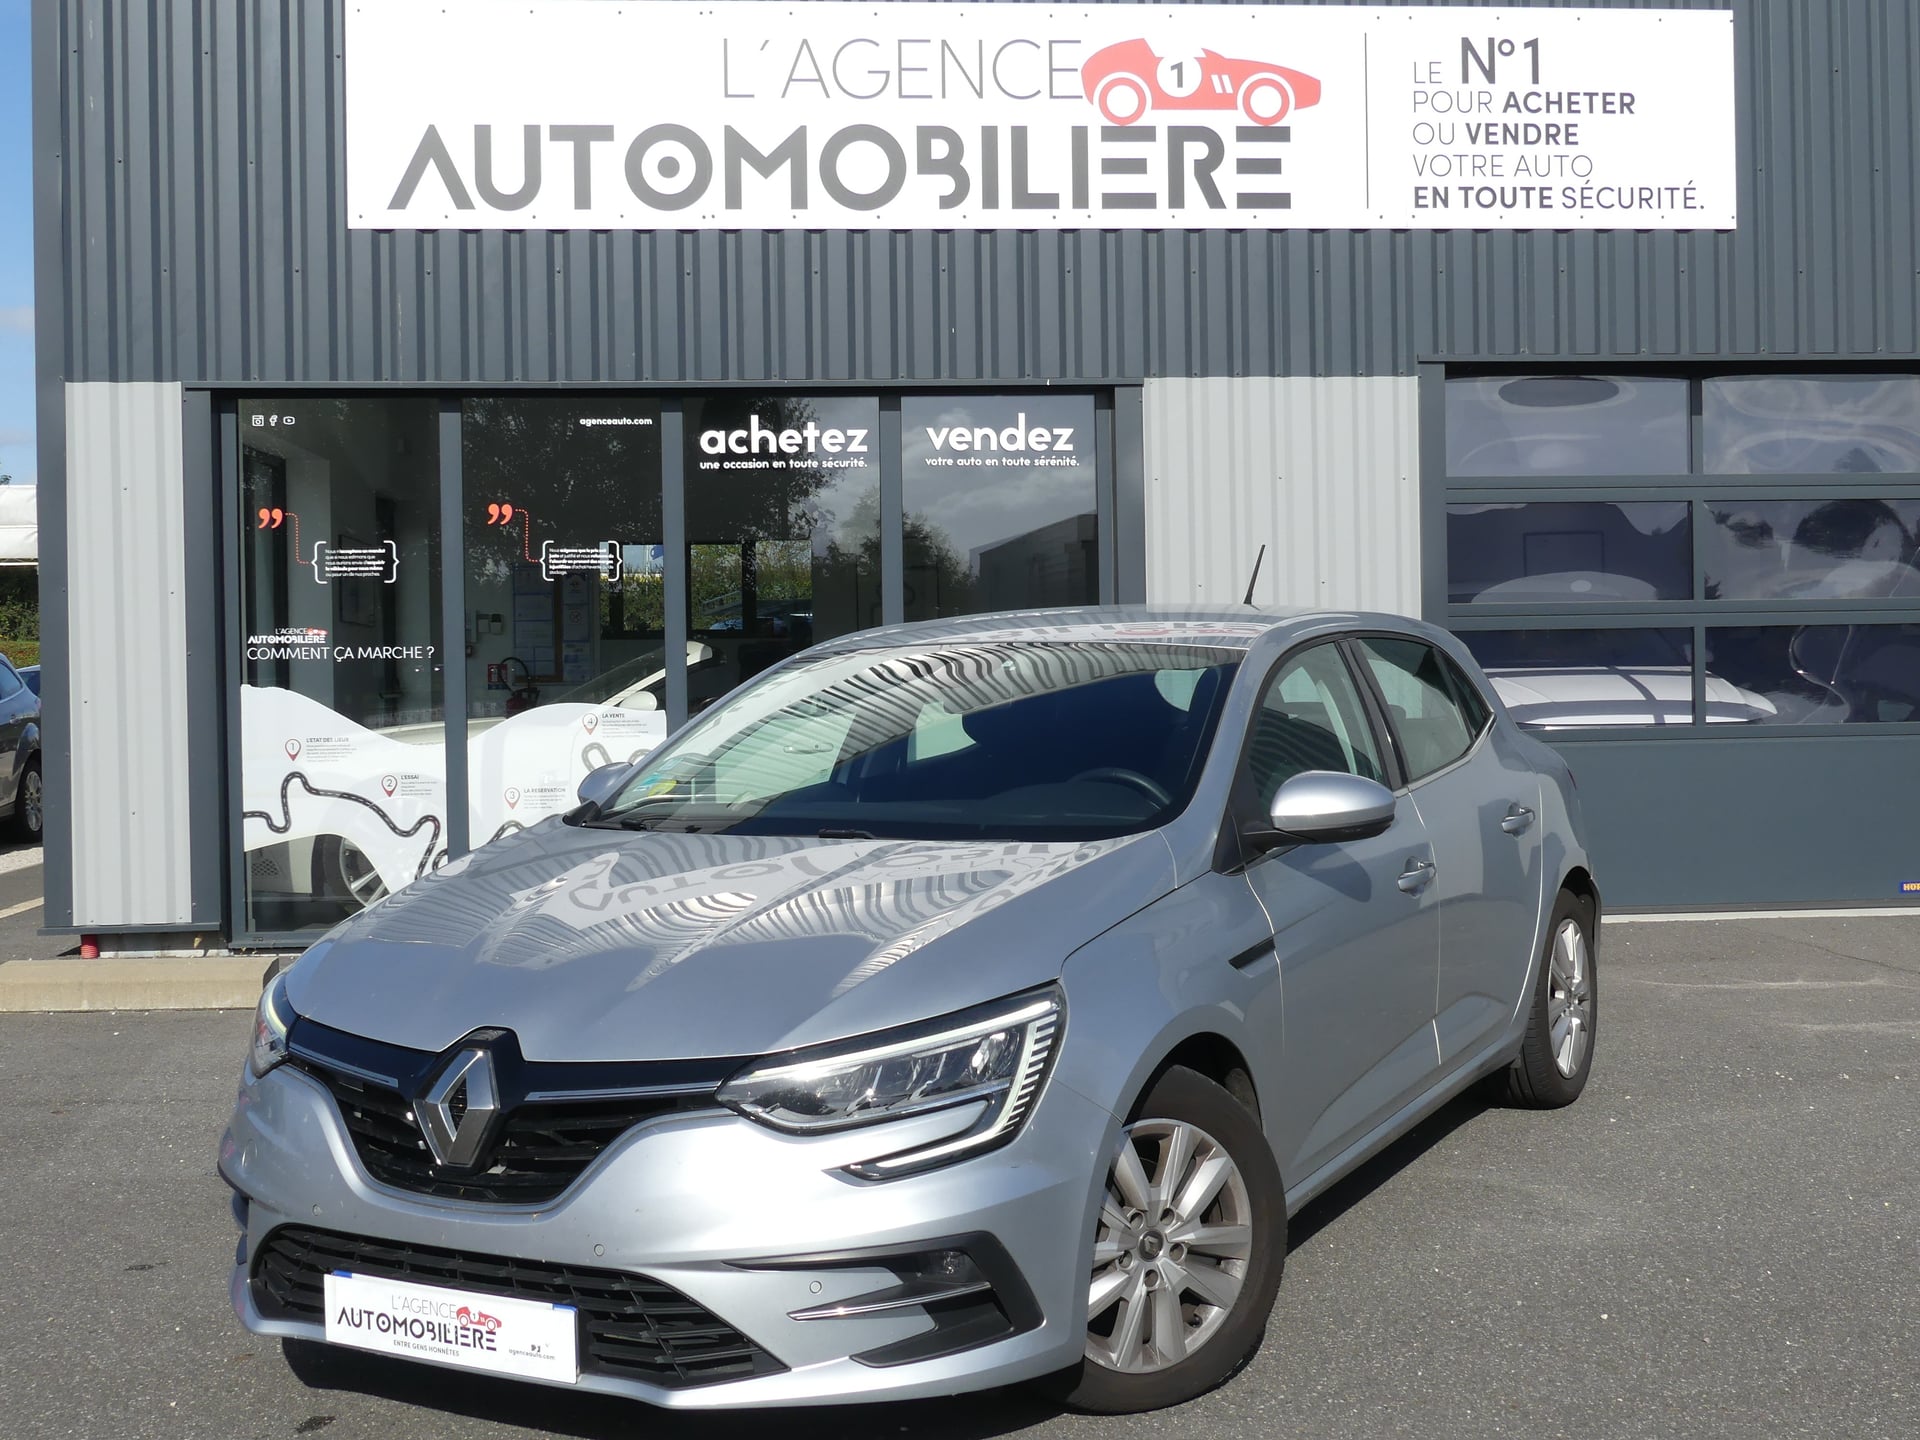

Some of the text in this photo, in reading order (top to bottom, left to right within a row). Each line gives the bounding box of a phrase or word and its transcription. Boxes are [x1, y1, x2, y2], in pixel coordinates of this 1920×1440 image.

[1170, 60, 1184, 88] 1
[1413, 61, 1443, 84] LE
[1413, 91, 1636, 115] POUR ACHETER
[1413, 122, 1579, 146] OU VENDRE
[1412, 153, 1593, 178] VOTRE AUTO
[1414, 179, 1705, 210] EN TOUTE SÉCURITÉ.
[579, 416, 653, 427] agenceauto.com
[926, 412, 1075, 452] vendez
[699, 414, 869, 455] achetez
[700, 456, 868, 469] une occasion en toute sécurité.
[925, 455, 1080, 466] votre auto en toute sérénité.
[246, 646, 330, 660] COMMENT
[333, 646, 354, 662] ÇA
[357, 646, 423, 660] MARCHE
[393, 1339, 411, 1349] ENTRE
[412, 1342, 428, 1351] GENS
